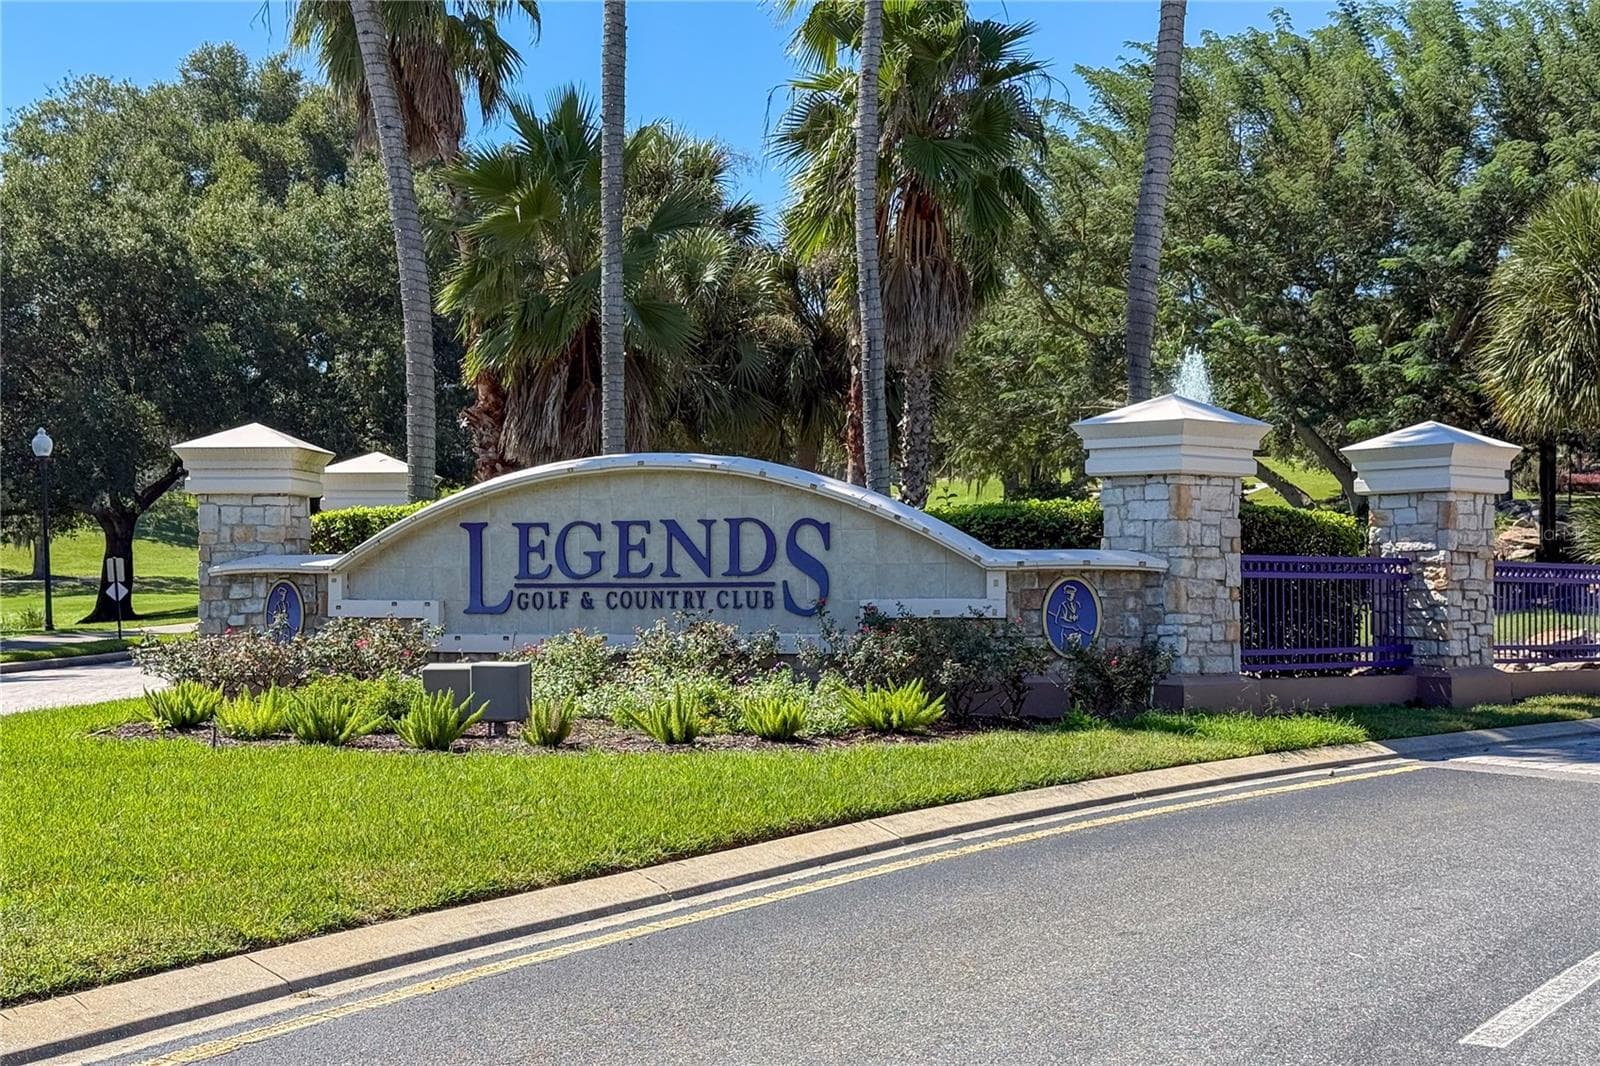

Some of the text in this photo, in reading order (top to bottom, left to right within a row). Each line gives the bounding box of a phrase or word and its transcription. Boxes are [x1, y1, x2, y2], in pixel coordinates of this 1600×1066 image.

[459, 517, 831, 617] LEGENDS
[516, 590, 775, 611] GOLF & COUNTRY CLUB
